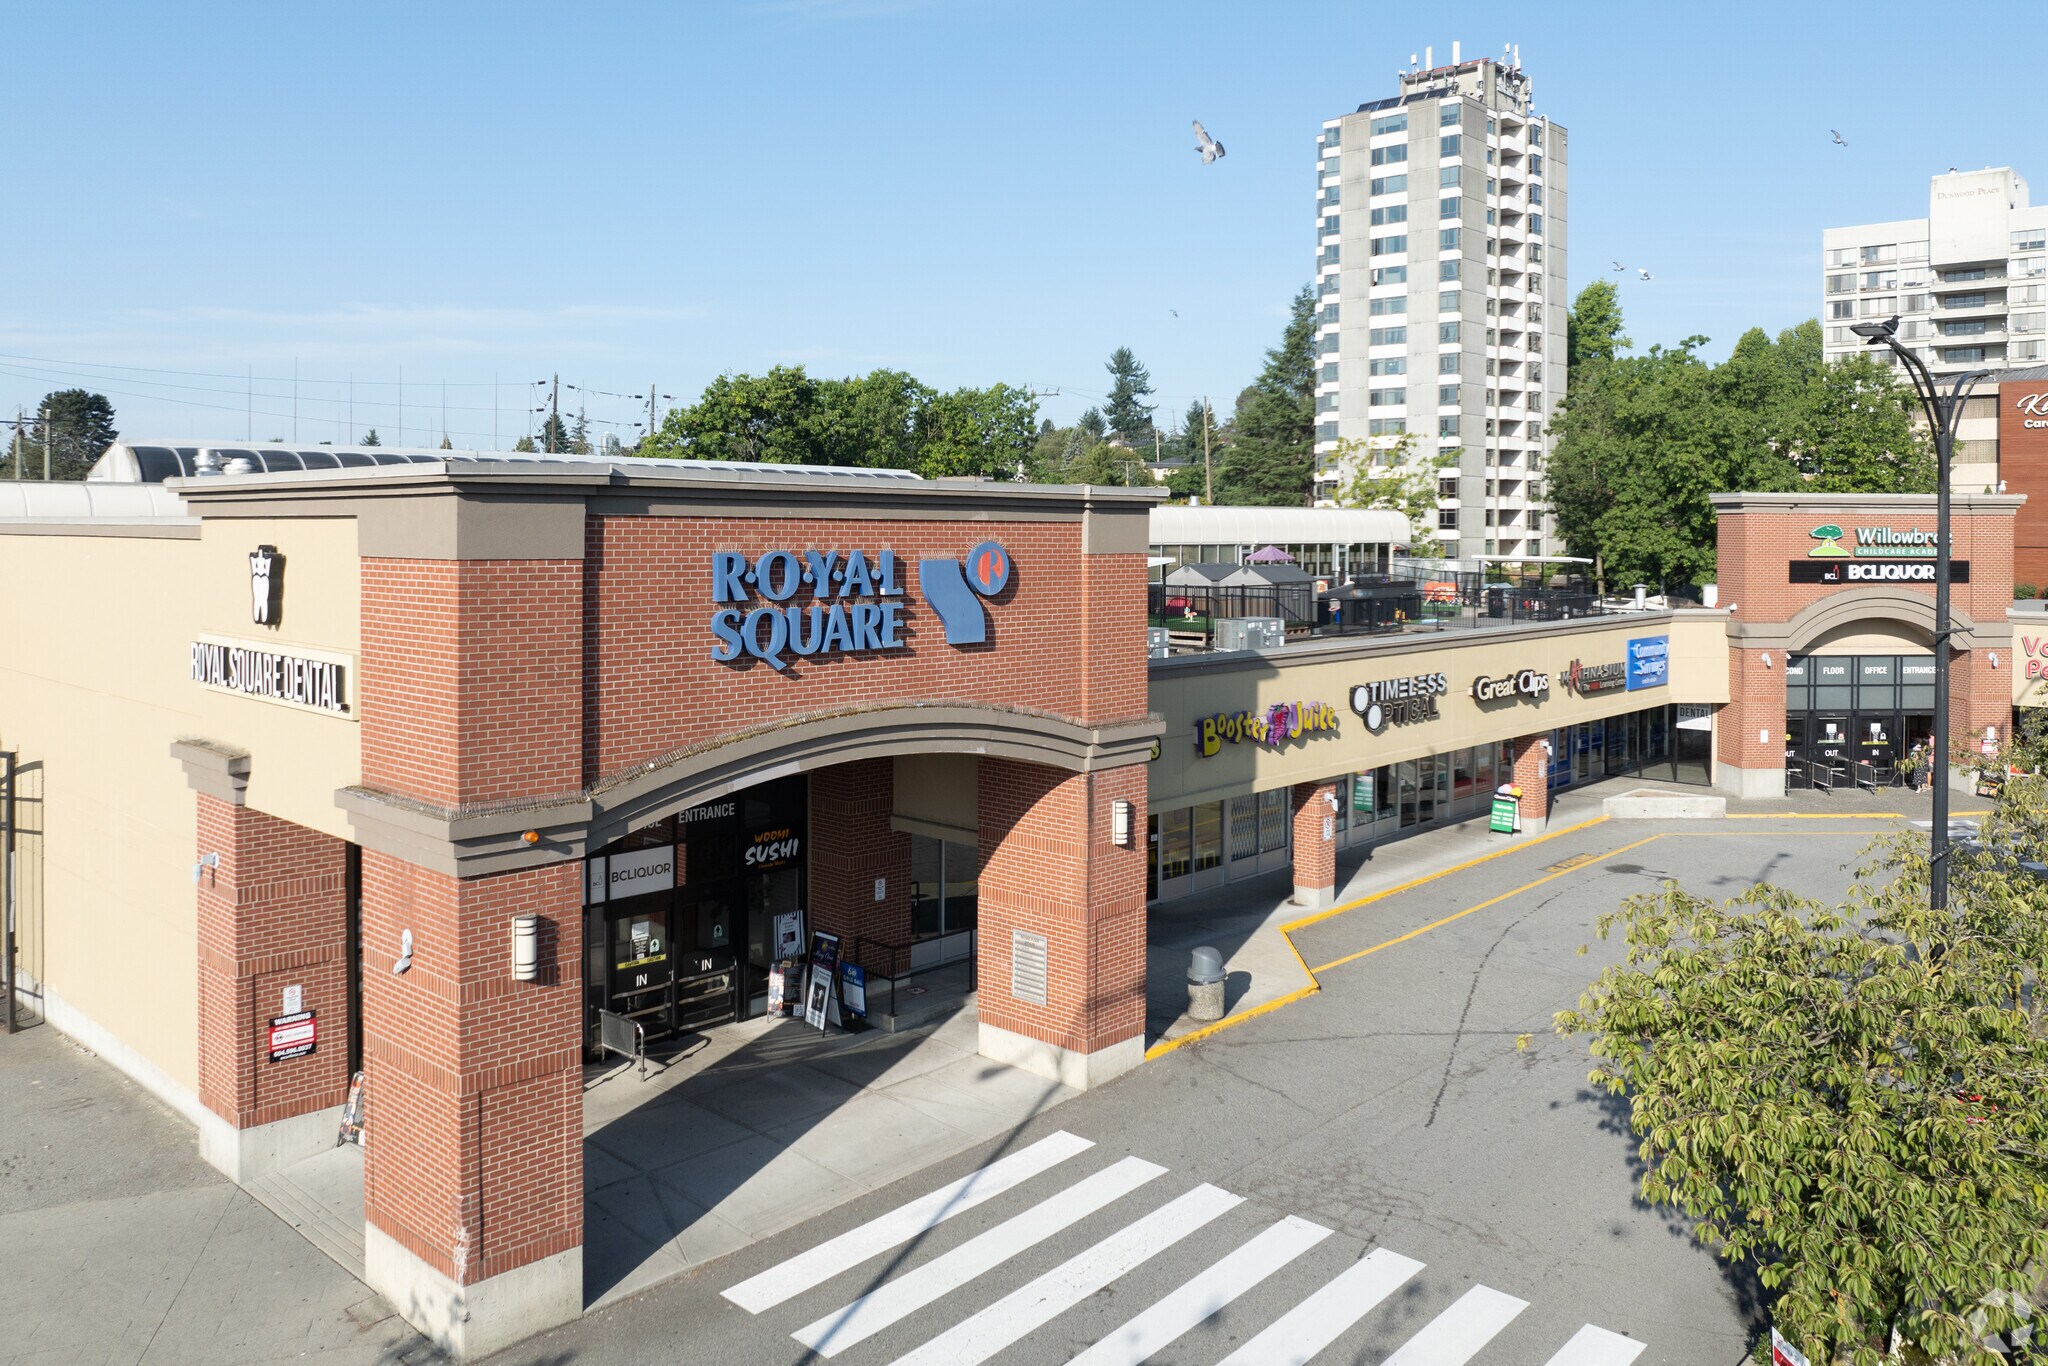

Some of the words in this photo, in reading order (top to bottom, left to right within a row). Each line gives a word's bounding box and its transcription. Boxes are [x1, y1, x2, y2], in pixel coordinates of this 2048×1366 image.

[1848, 564, 1936, 580] BCLIQUOR
[710, 601, 904, 671] SQUARE
[191, 641, 228, 687] ROYAL
[229, 647, 282, 698] SQUARE
[283, 657, 344, 710] DENTAL
[1786, 667, 1804, 675] COND
[1823, 667, 1845, 675] FLOOR
[1865, 667, 1888, 675] OFFICE
[1903, 666, 1937, 675] ENTRANCE
[1367, 672, 1446, 702] TIMELESS
[1476, 677, 1517, 701] Great
[1518, 670, 1549, 697] Clips
[1680, 707, 1710, 719] DENTAL
[1200, 711, 1269, 757] Booster
[1290, 700, 1336, 739] Juice
[678, 803, 736, 824] ENTRANCE
[754, 828, 790, 843] WOOMI
[744, 838, 799, 866] SUSHI
[611, 862, 671, 883] BCLIQUOR
[701, 958, 713, 971] IN
[636, 973, 648, 987] IN
[274, 1012, 312, 1026] WARNING
